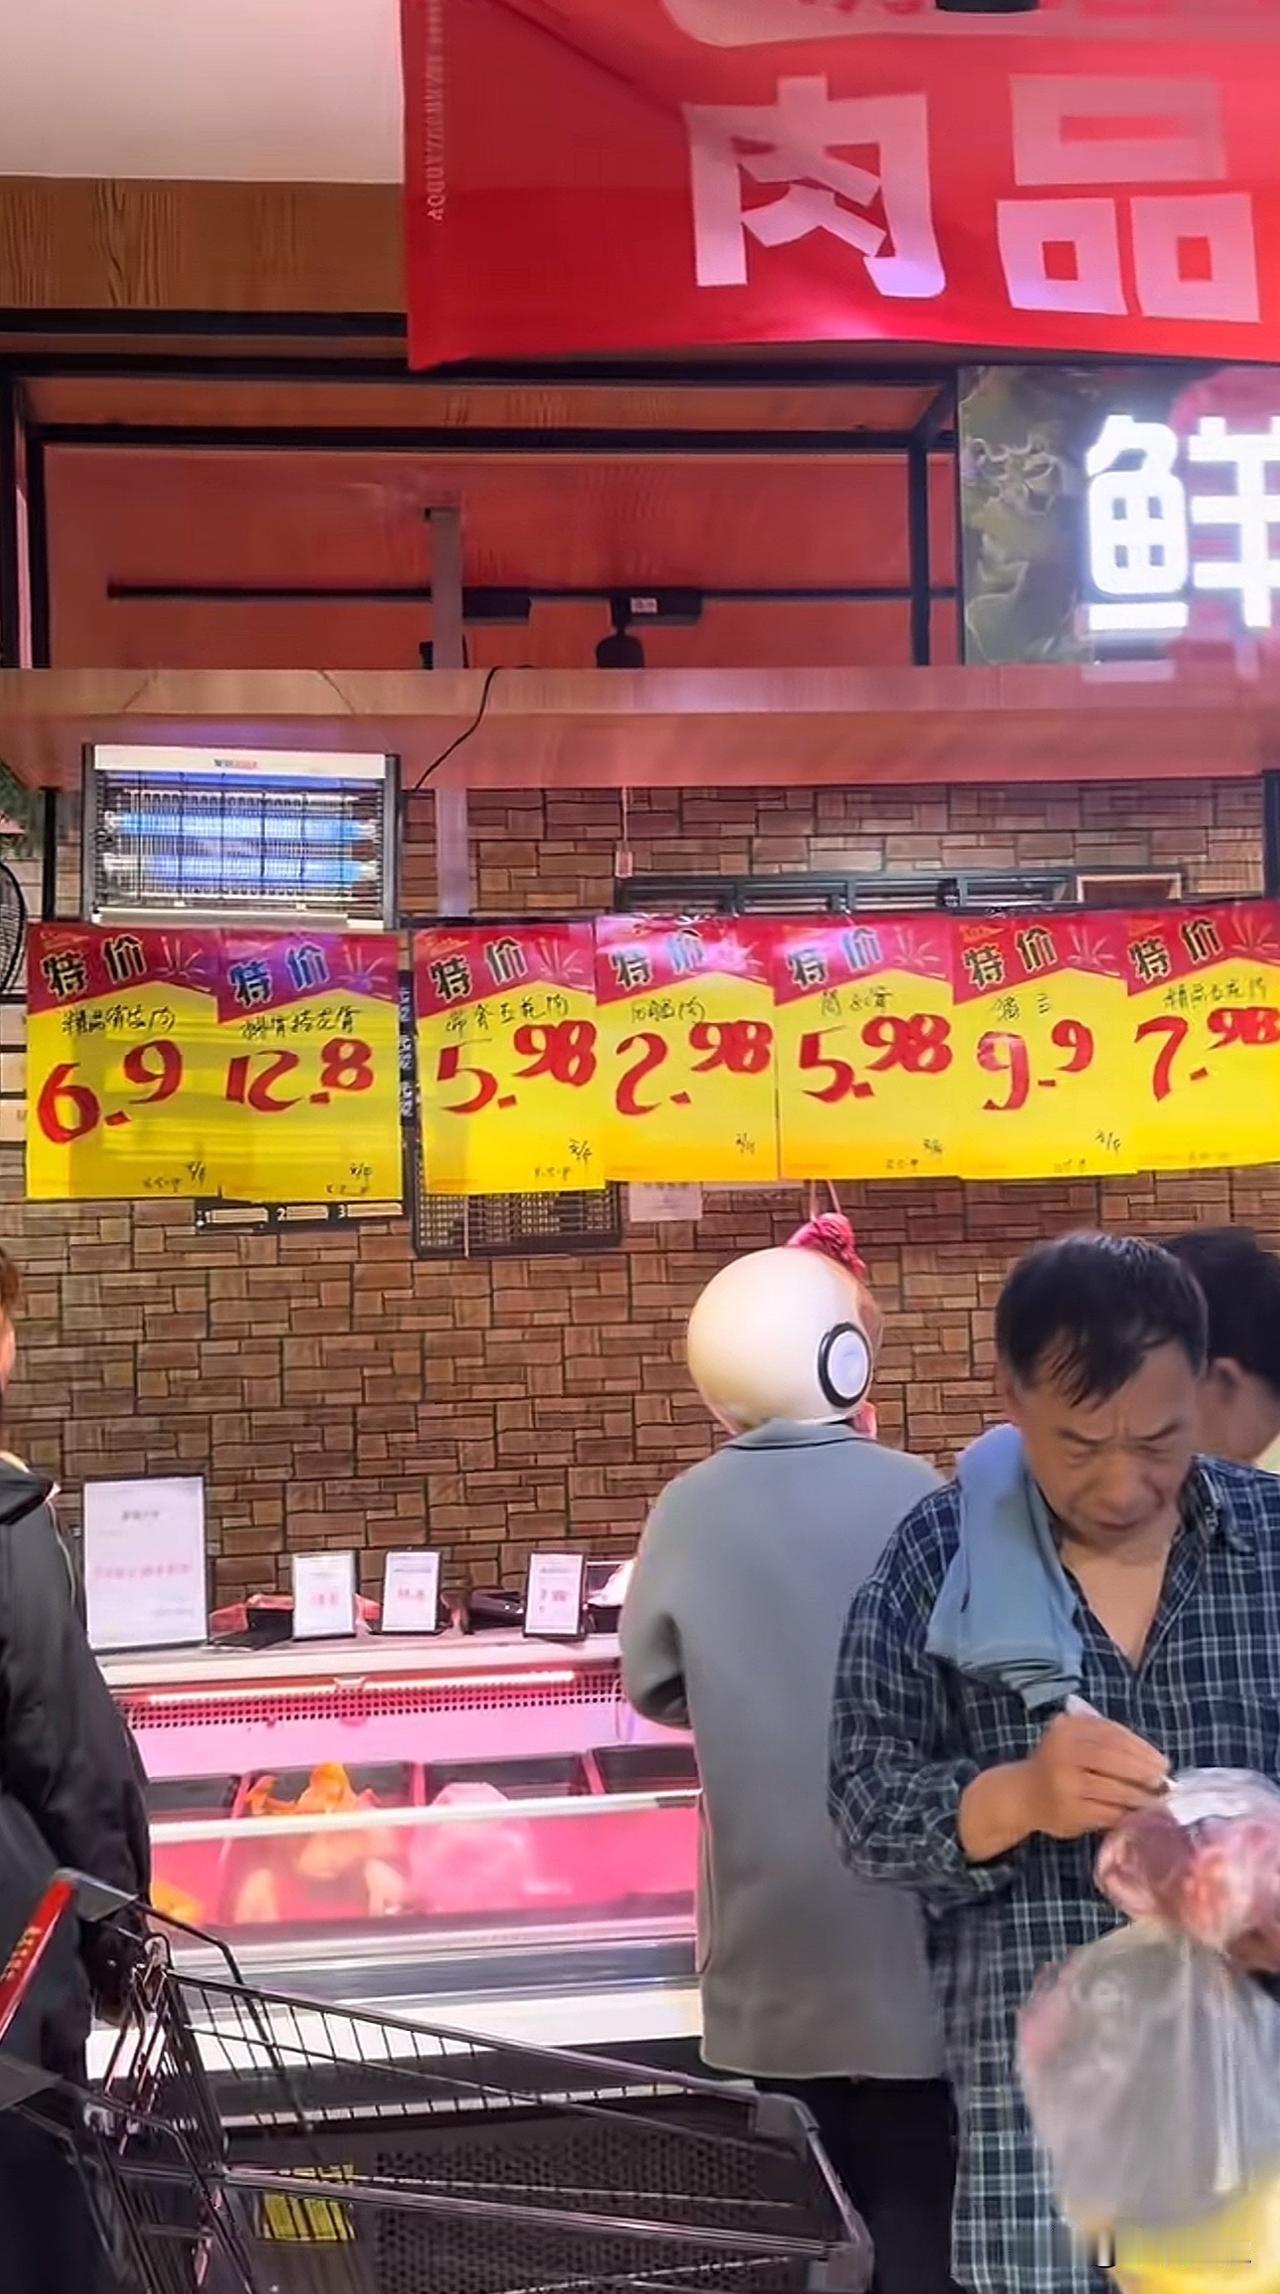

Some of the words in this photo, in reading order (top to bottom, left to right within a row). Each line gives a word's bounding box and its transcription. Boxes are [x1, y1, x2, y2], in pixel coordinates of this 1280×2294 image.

[682, 72, 1261, 324] 肉品
[1085, 413, 1280, 630] 鲜
[41, 933, 146, 1000] 特价
[228, 942, 329, 1008] 特价
[429, 935, 528, 1000] 特价
[610, 930, 705, 990] 特价
[786, 925, 883, 988] 特价
[963, 925, 1058, 992] 特价
[1127, 917, 1222, 982] 特价
[225, 1037, 375, 1113] 12.8
[436, 1018, 598, 1115] 5.98
[614, 1018, 774, 1117] 2.98
[797, 1011, 954, 1104] 5.98
[975, 1018, 1095, 1112] 9.9
[1134, 1005, 1280, 1102] 7.98
[37, 1041, 183, 1145] 6.9
[276, 1207, 287, 1222] 2
[337, 1203, 347, 1219] 3
